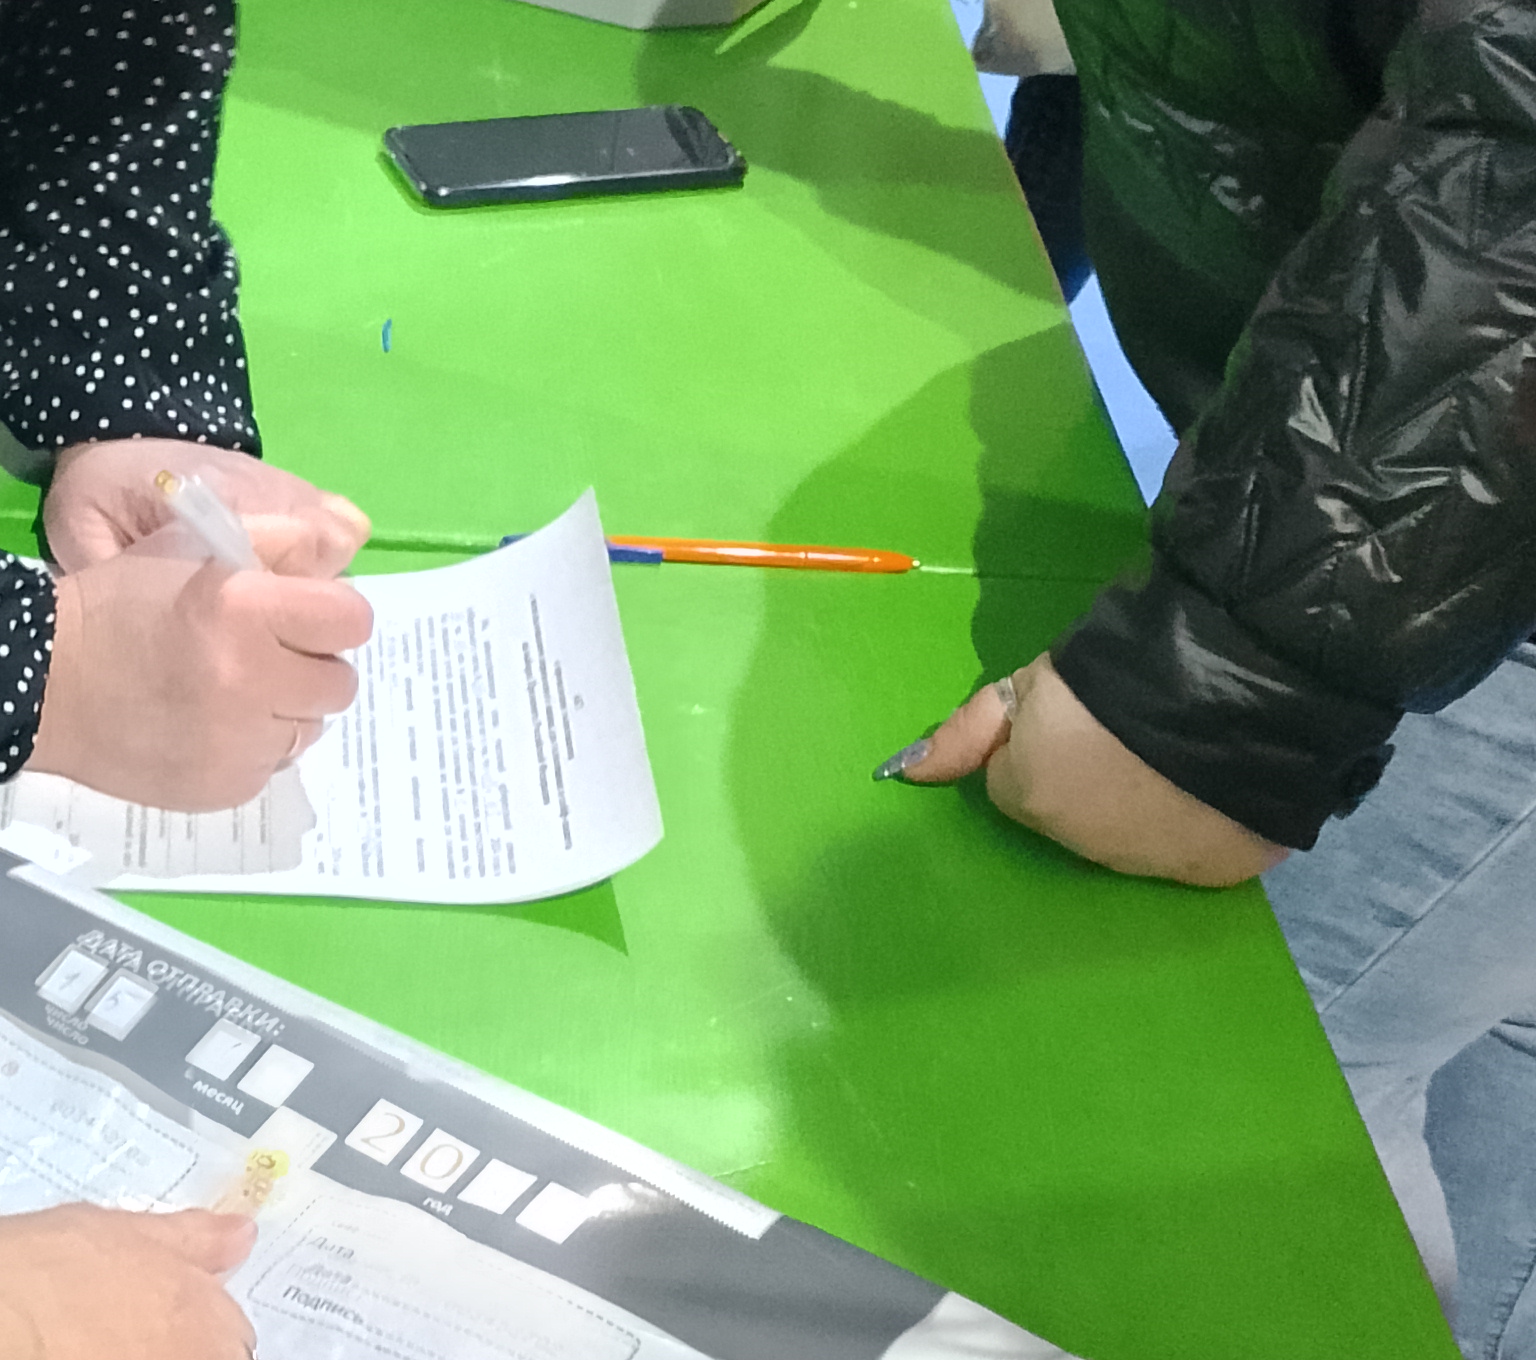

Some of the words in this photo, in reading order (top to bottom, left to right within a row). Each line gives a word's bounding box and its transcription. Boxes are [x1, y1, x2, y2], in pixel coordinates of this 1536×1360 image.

[76, 929, 144, 973] ДАТА
[192, 1080, 245, 1116] месяц
[281, 1284, 364, 1326] Подпись
